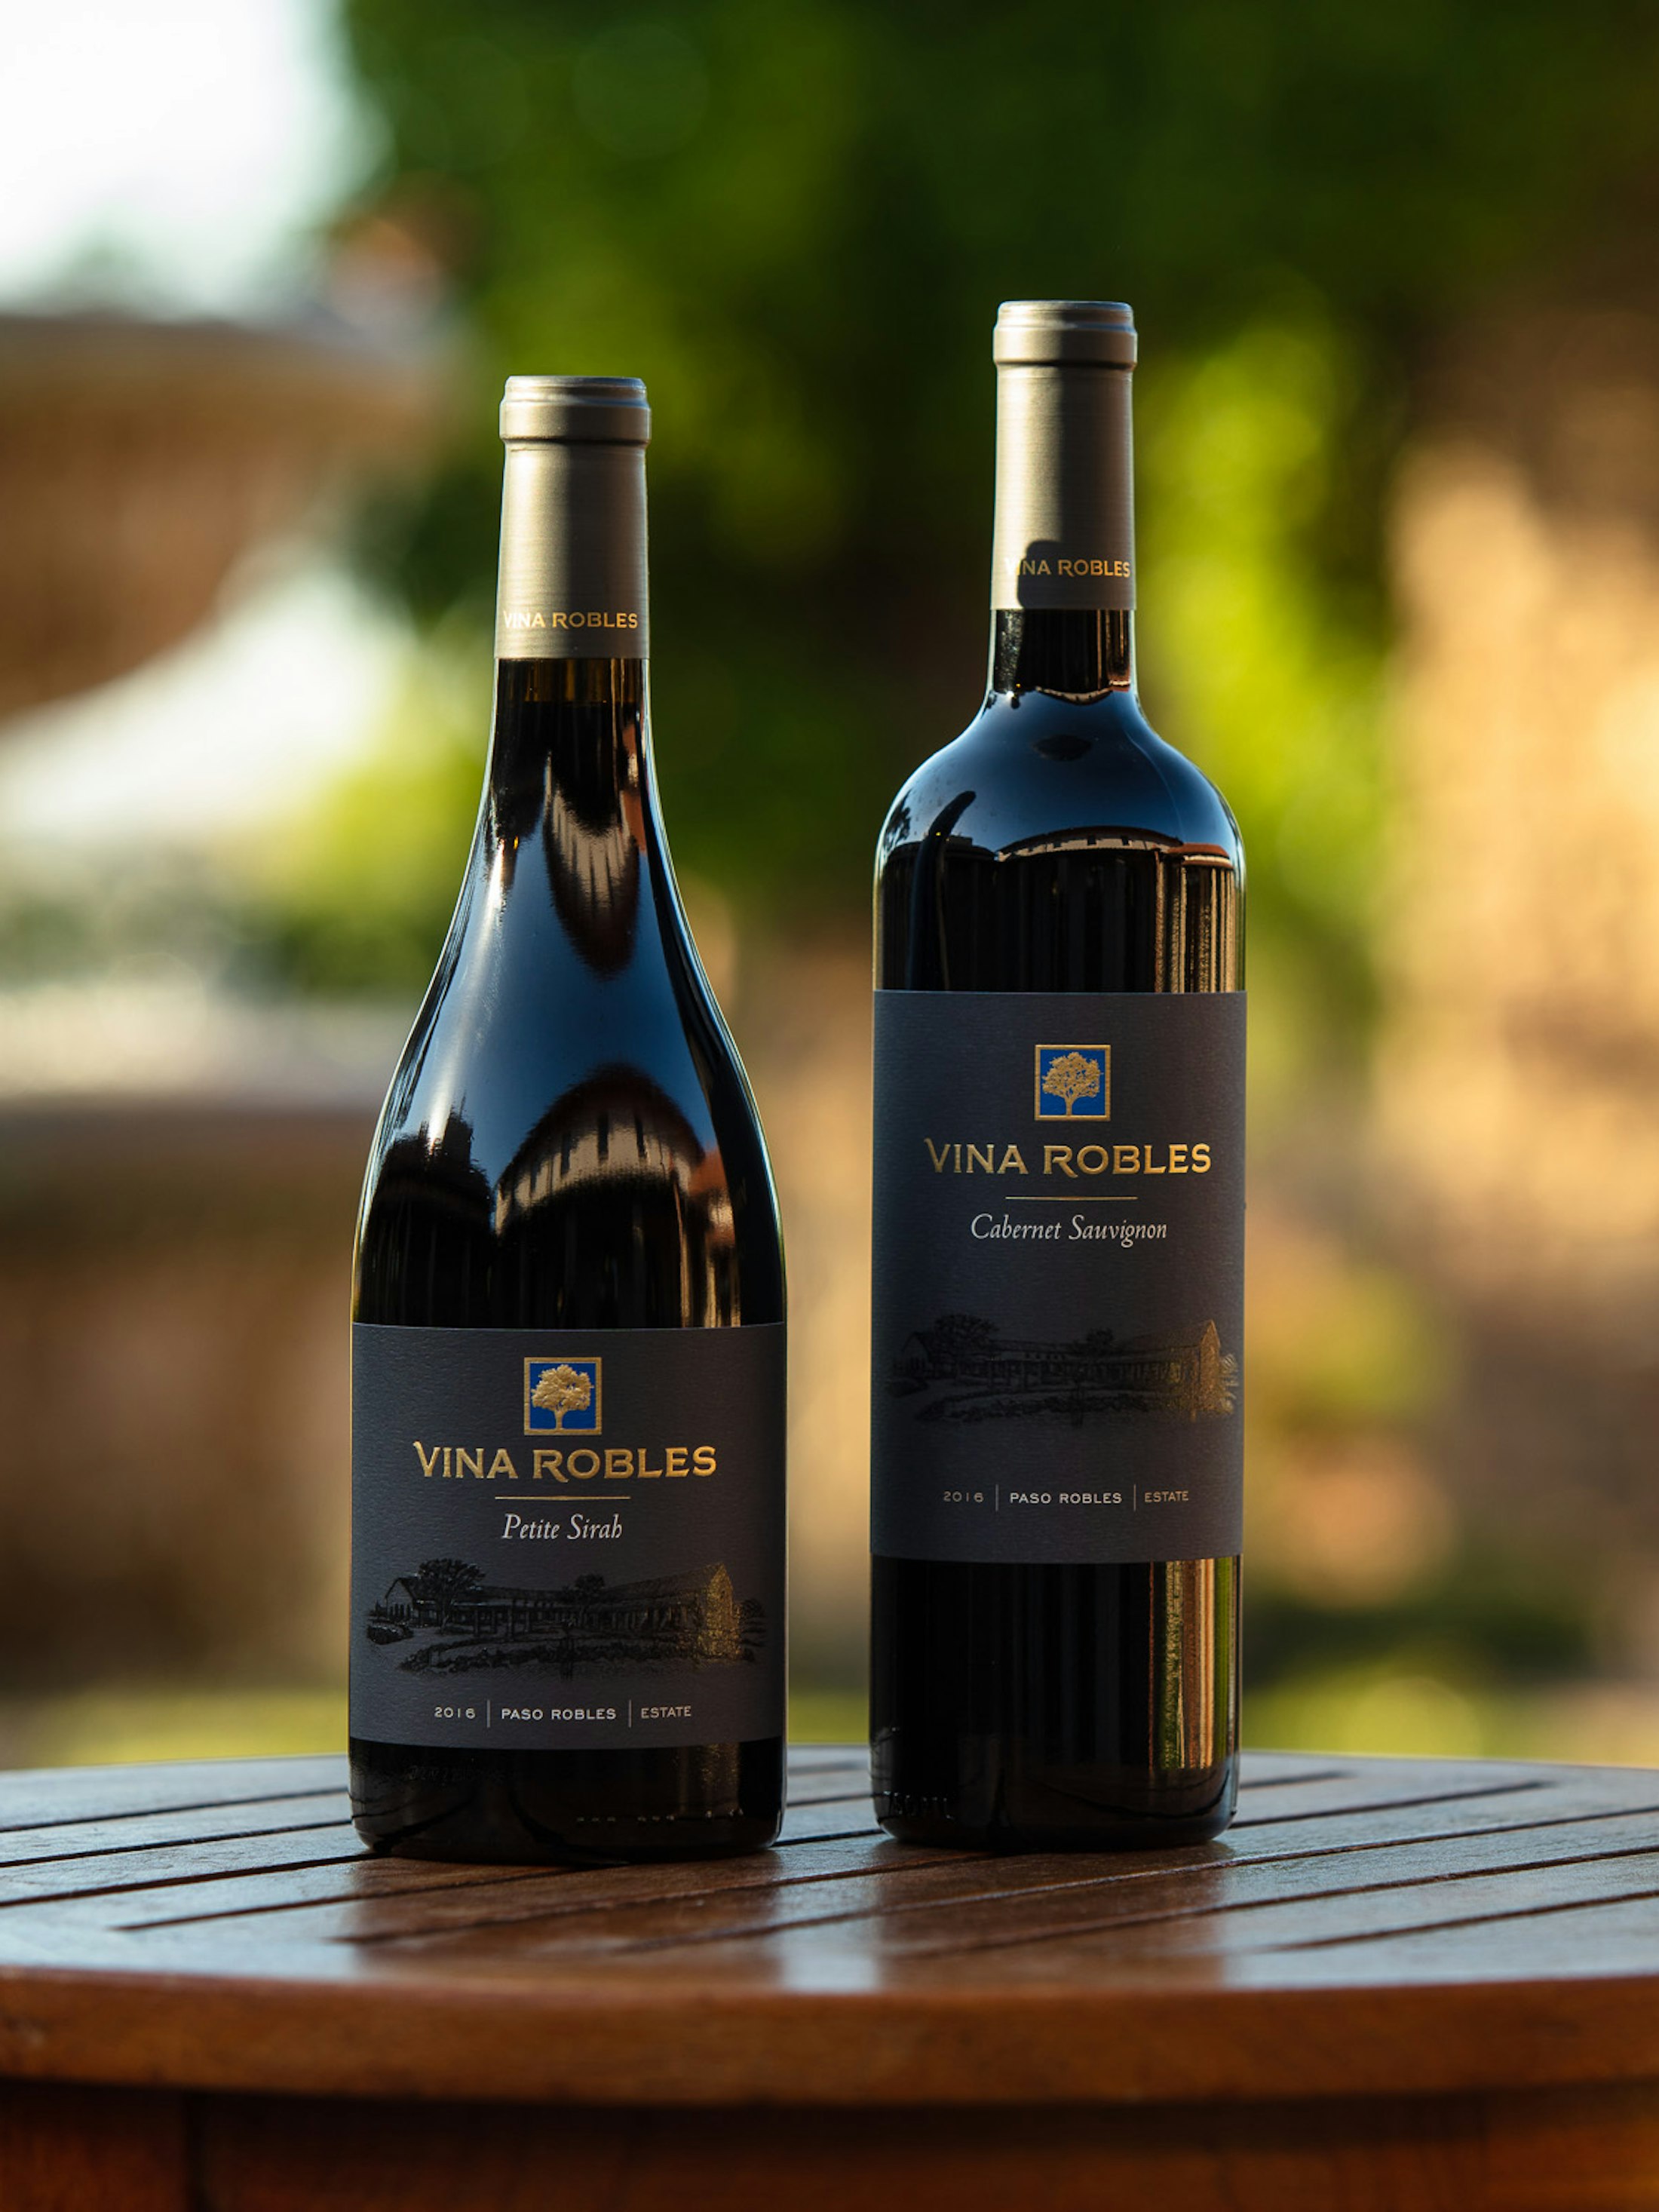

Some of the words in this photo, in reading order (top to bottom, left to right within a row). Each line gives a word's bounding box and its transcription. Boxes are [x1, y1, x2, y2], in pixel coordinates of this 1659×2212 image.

[1058, 559, 1130, 578] ROBLES
[503, 611, 546, 628] VINA
[552, 612, 639, 630] ROBLES
[924, 1137, 1029, 1175] VINA
[1043, 1143, 1212, 1179] ROBLES
[970, 1213, 1062, 1241] Cabernet
[1068, 1214, 1168, 1249] Sauvignon
[412, 1440, 519, 1480] VINA
[532, 1446, 718, 1483] ROBLES
[943, 1490, 984, 1503] 2016
[1010, 1492, 1053, 1505] PASO
[1059, 1492, 1123, 1505] ROBLES
[1144, 1489, 1189, 1503] ESTATE
[501, 1513, 560, 1540] Petite
[567, 1514, 624, 1541] Sirah
[434, 1706, 476, 1720] 2016
[501, 1707, 544, 1721] PASO
[550, 1707, 617, 1721] ROBLES
[641, 1705, 692, 1720] ESTATE
